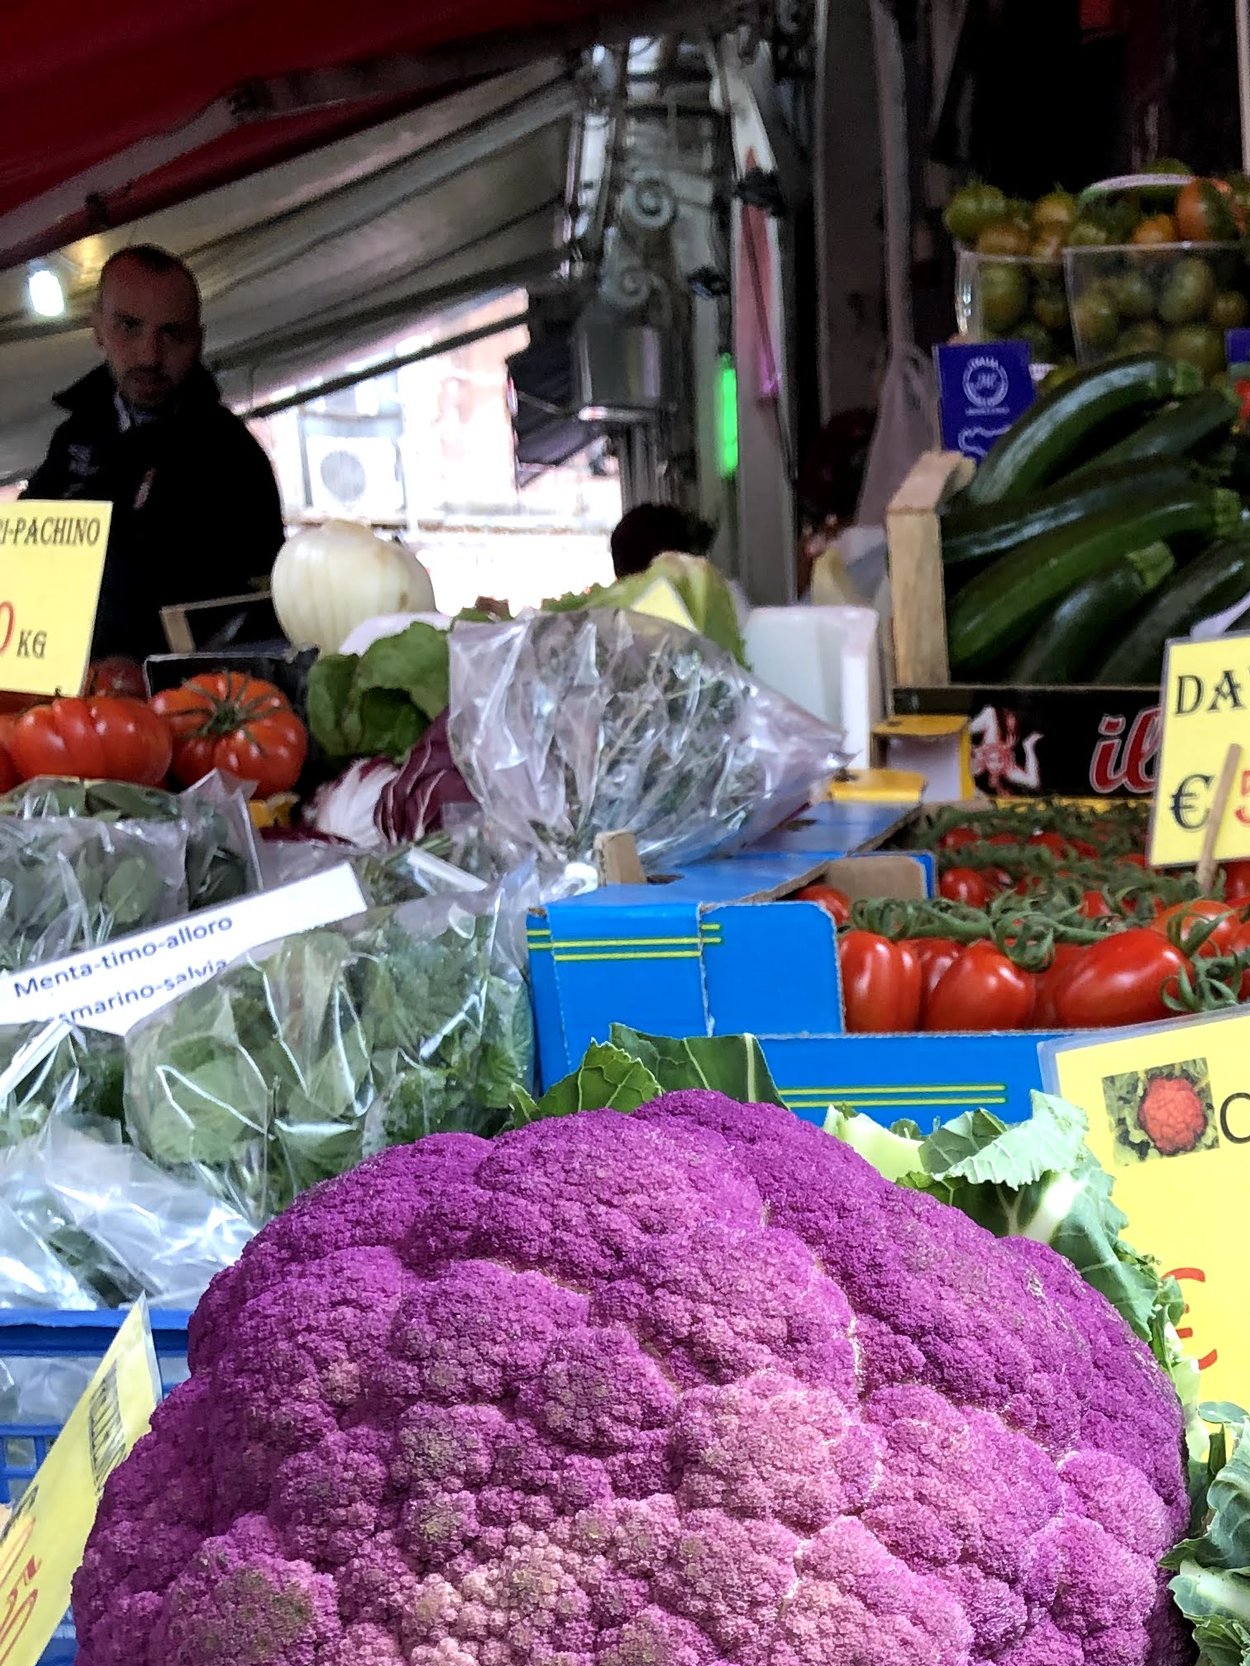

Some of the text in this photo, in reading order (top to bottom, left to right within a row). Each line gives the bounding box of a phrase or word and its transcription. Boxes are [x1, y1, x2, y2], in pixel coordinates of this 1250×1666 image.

[16, 629, 48, 659] KG
[1170, 773, 1214, 832] €
[13, 916, 233, 998] Menta-timo-alloro
